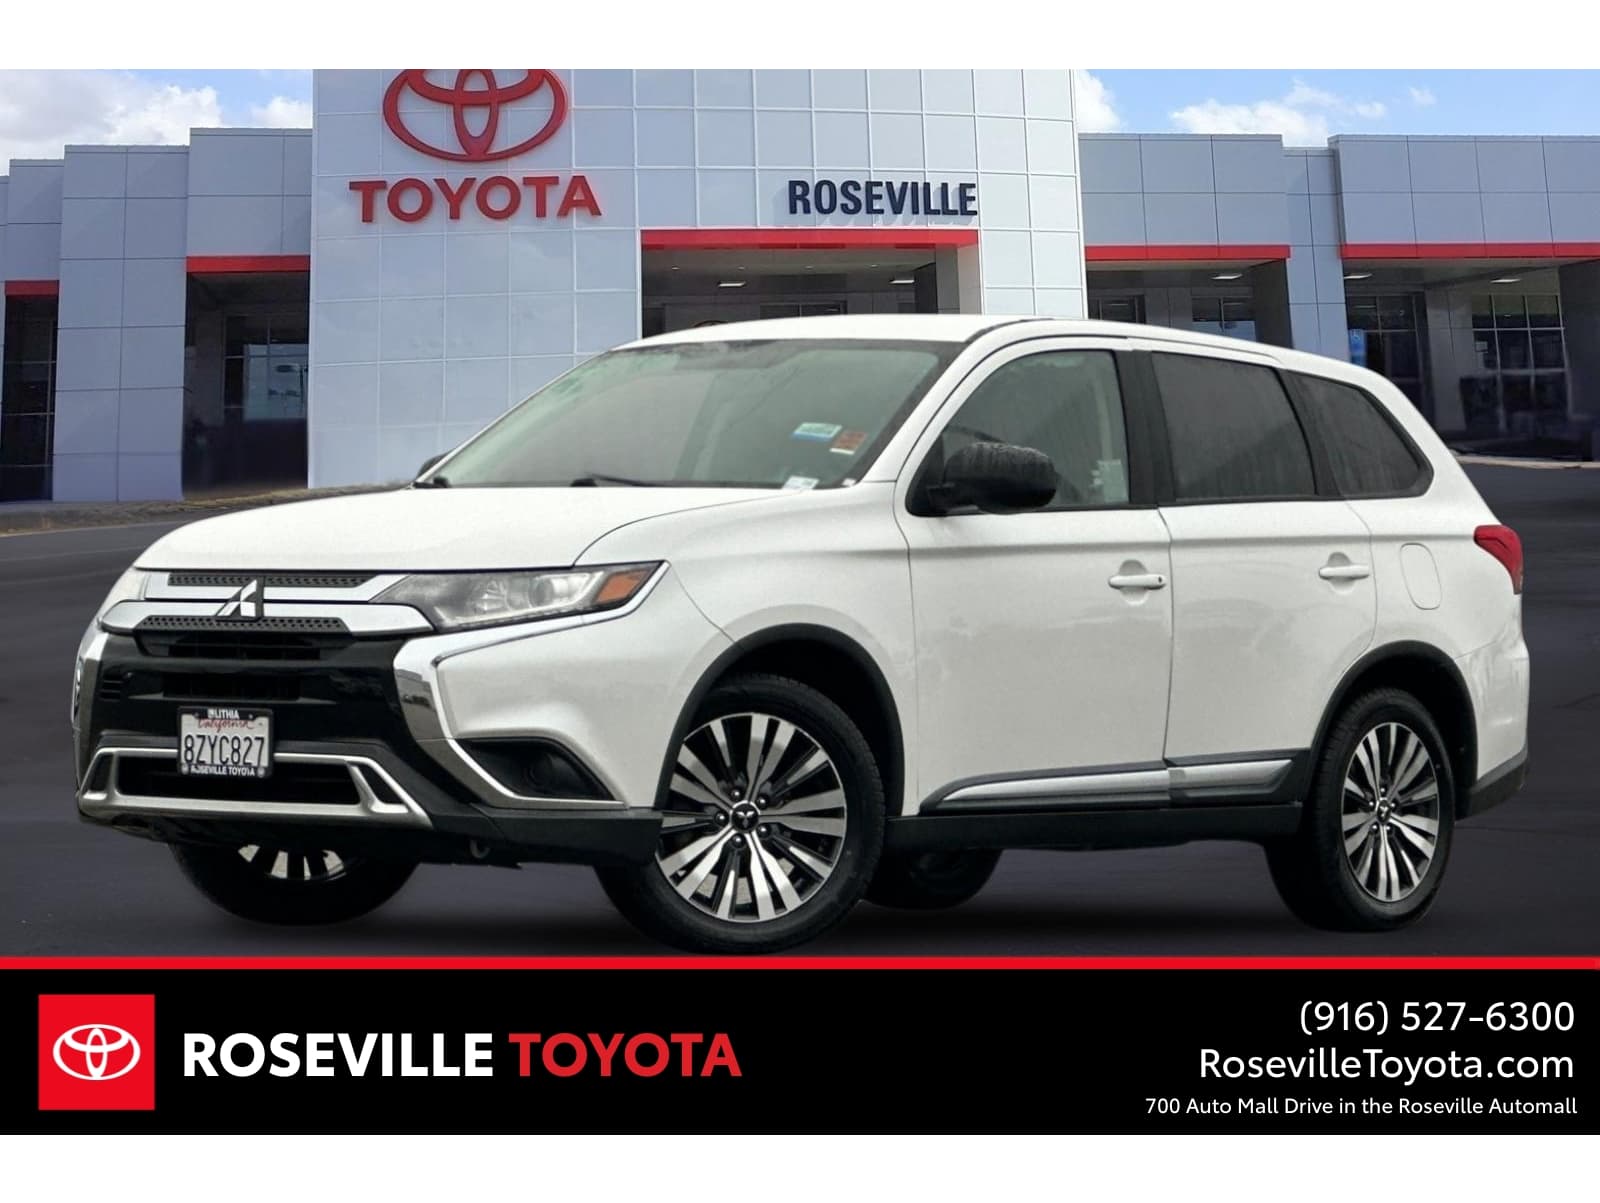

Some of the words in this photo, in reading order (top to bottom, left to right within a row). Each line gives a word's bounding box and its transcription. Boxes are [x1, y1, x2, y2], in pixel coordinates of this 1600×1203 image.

[349, 175, 601, 223] TOYOTA
[788, 180, 978, 216] ROSEVILLE
[184, 734, 265, 766] 8ZYC827
